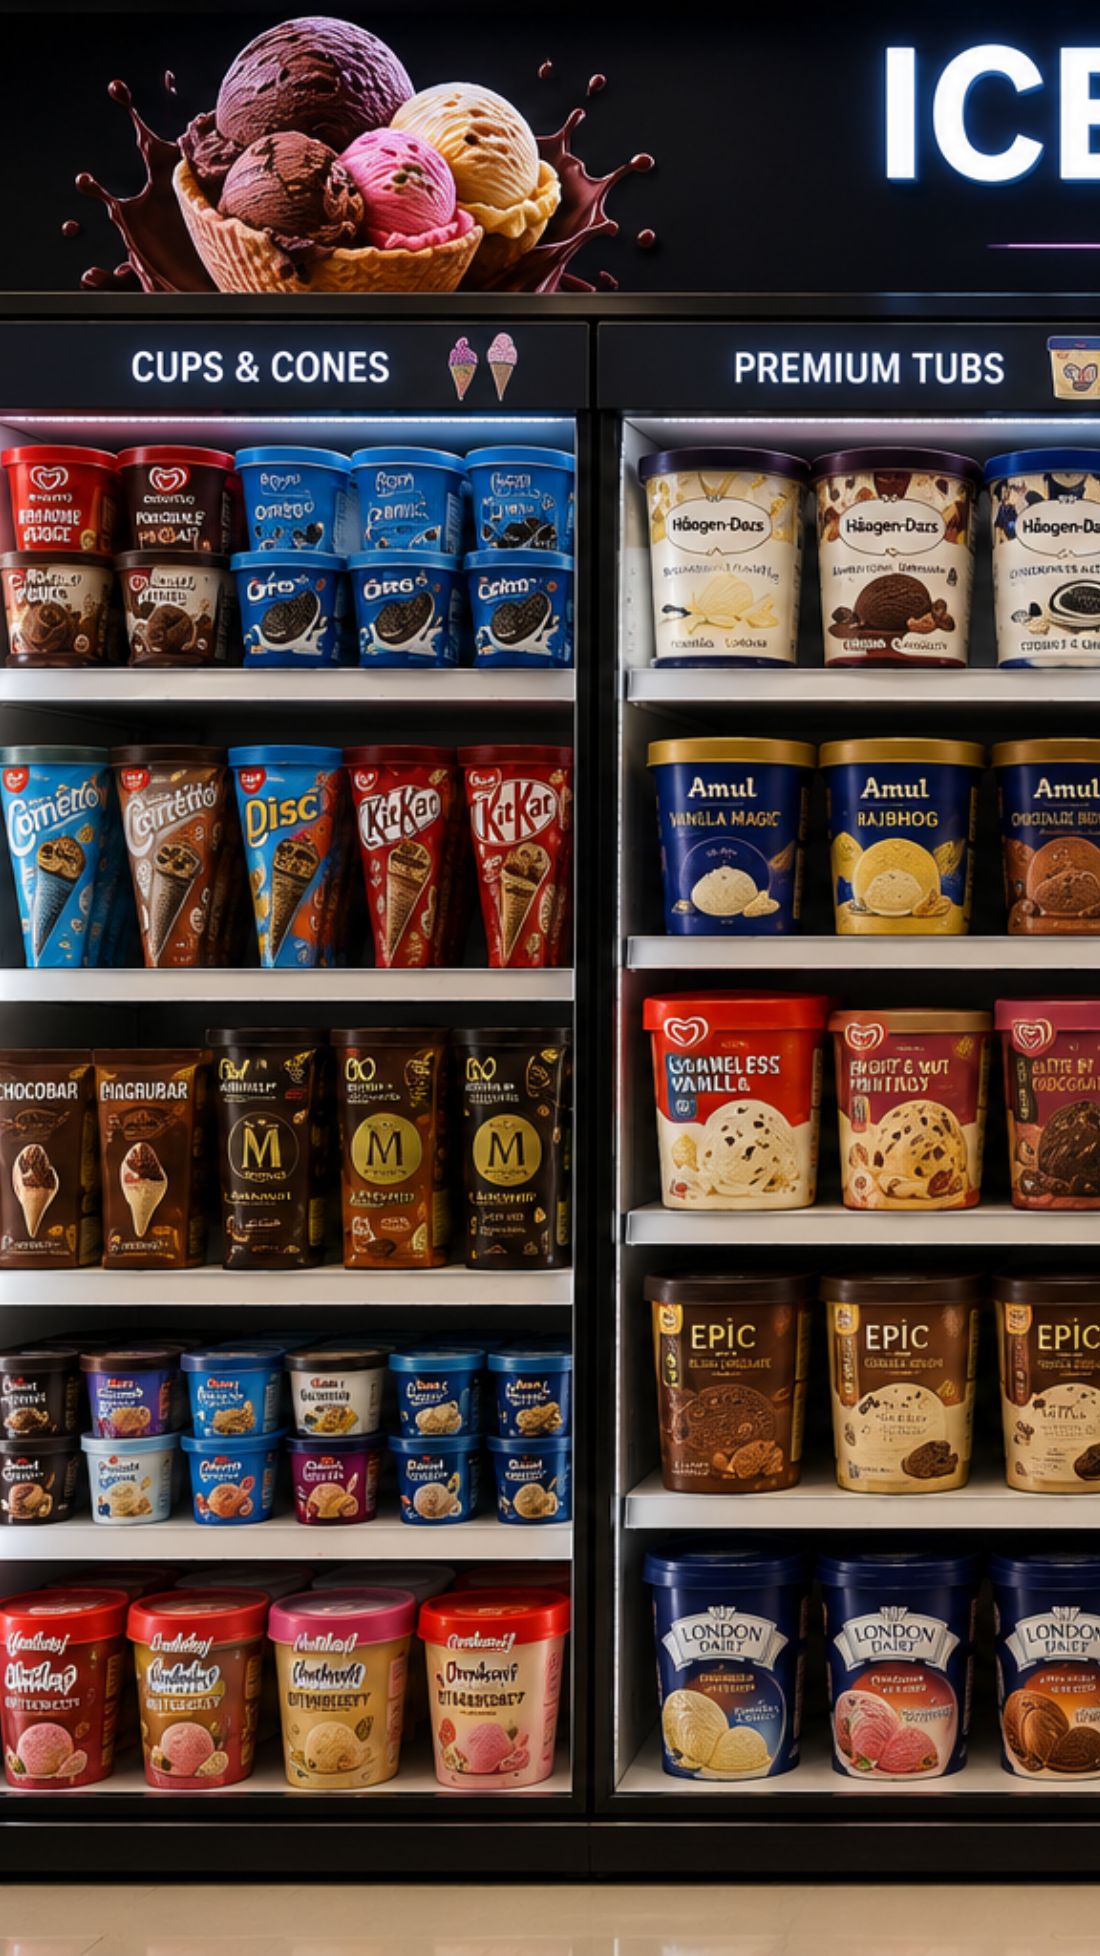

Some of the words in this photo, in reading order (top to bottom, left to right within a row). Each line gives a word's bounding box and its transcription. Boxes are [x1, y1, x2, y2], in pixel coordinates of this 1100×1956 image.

[886, 43, 1100, 184] ICE
[131, 350, 224, 383] CUPS
[235, 350, 260, 383] &
[271, 350, 390, 383] CONES
[734, 351, 900, 384] PREMIUM
[912, 351, 1005, 384] TUBS
[687, 776, 758, 798] Amul
[860, 776, 930, 799] Amul
[1033, 776, 1100, 799] Amul
[241, 1126, 282, 1169] M
[366, 1128, 404, 1166] M
[487, 1130, 526, 1168] M
[682, 1623, 763, 1643] LONDON
[854, 1623, 936, 1643] LONDON
